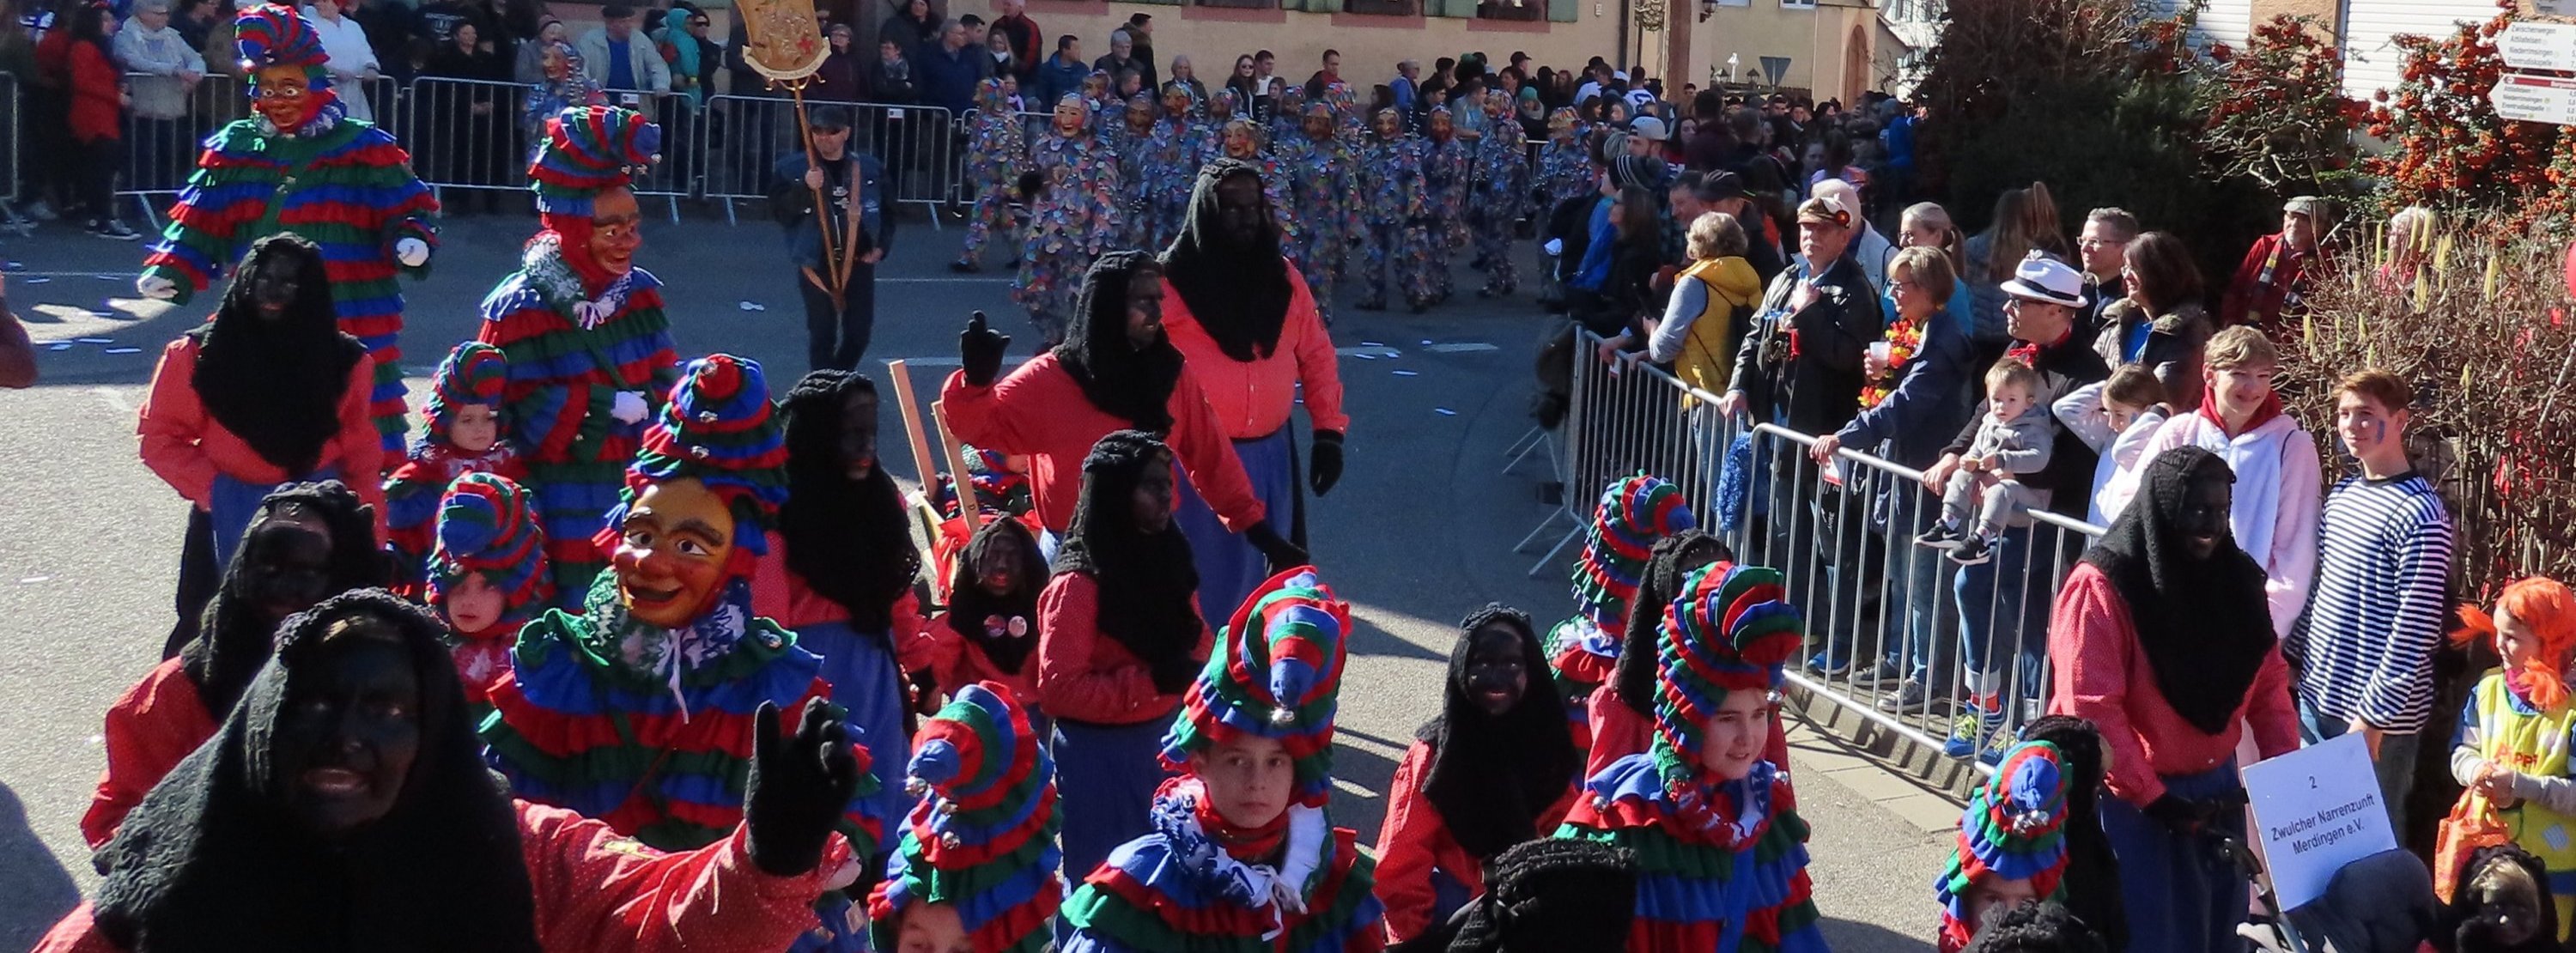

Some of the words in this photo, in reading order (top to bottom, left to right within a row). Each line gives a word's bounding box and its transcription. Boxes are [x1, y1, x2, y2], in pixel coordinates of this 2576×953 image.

[2309, 775, 2318, 789] 2
[2271, 816, 2317, 841] Zwulcher
[2317, 793, 2375, 824] Narrenzunft
[2292, 827, 2345, 855] Merdingen
[2346, 817, 2365, 835] e.V.
